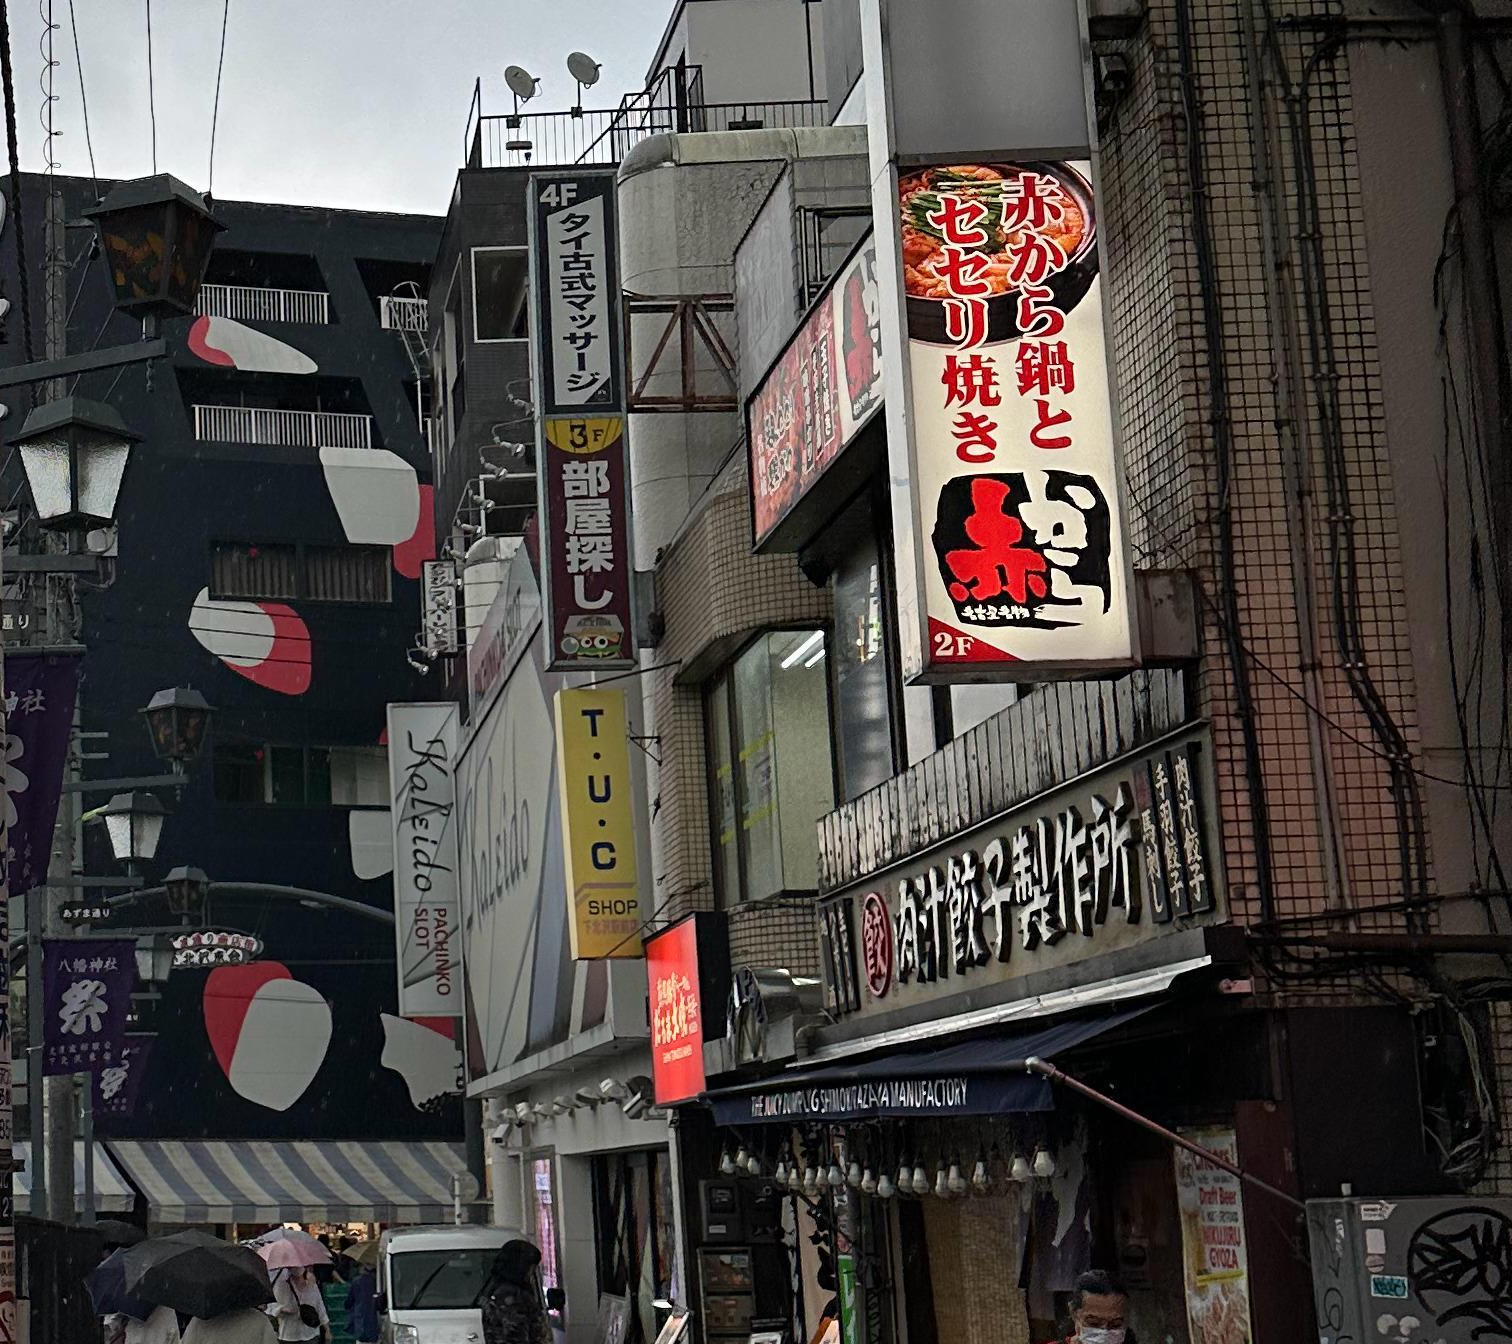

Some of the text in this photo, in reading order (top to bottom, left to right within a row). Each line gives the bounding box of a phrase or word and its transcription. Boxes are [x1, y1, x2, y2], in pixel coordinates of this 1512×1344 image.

[539, 183, 578, 207] 4F
[558, 212, 600, 393] タイ古式マッサージ
[932, 195, 1002, 464] セセリ焼き
[1000, 172, 1075, 451] 赤から鍋と
[562, 460, 614, 610] 部屋探し
[944, 472, 1110, 626] 赤から
[934, 631, 975, 658] 2F
[405, 730, 454, 893] Kaleido
[63, 908, 111, 919] あずま通り
[588, 899, 638, 915] SHOP
[894, 783, 1138, 984] 肉汁餃子製作所
[415, 907, 429, 950] SLOT
[433, 907, 451, 997] PACHINKO
[58, 978, 109, 1036] 祭
[1199, 1187, 1237, 1206] Draft Beer
[1209, 1247, 1239, 1269] GYOZA
